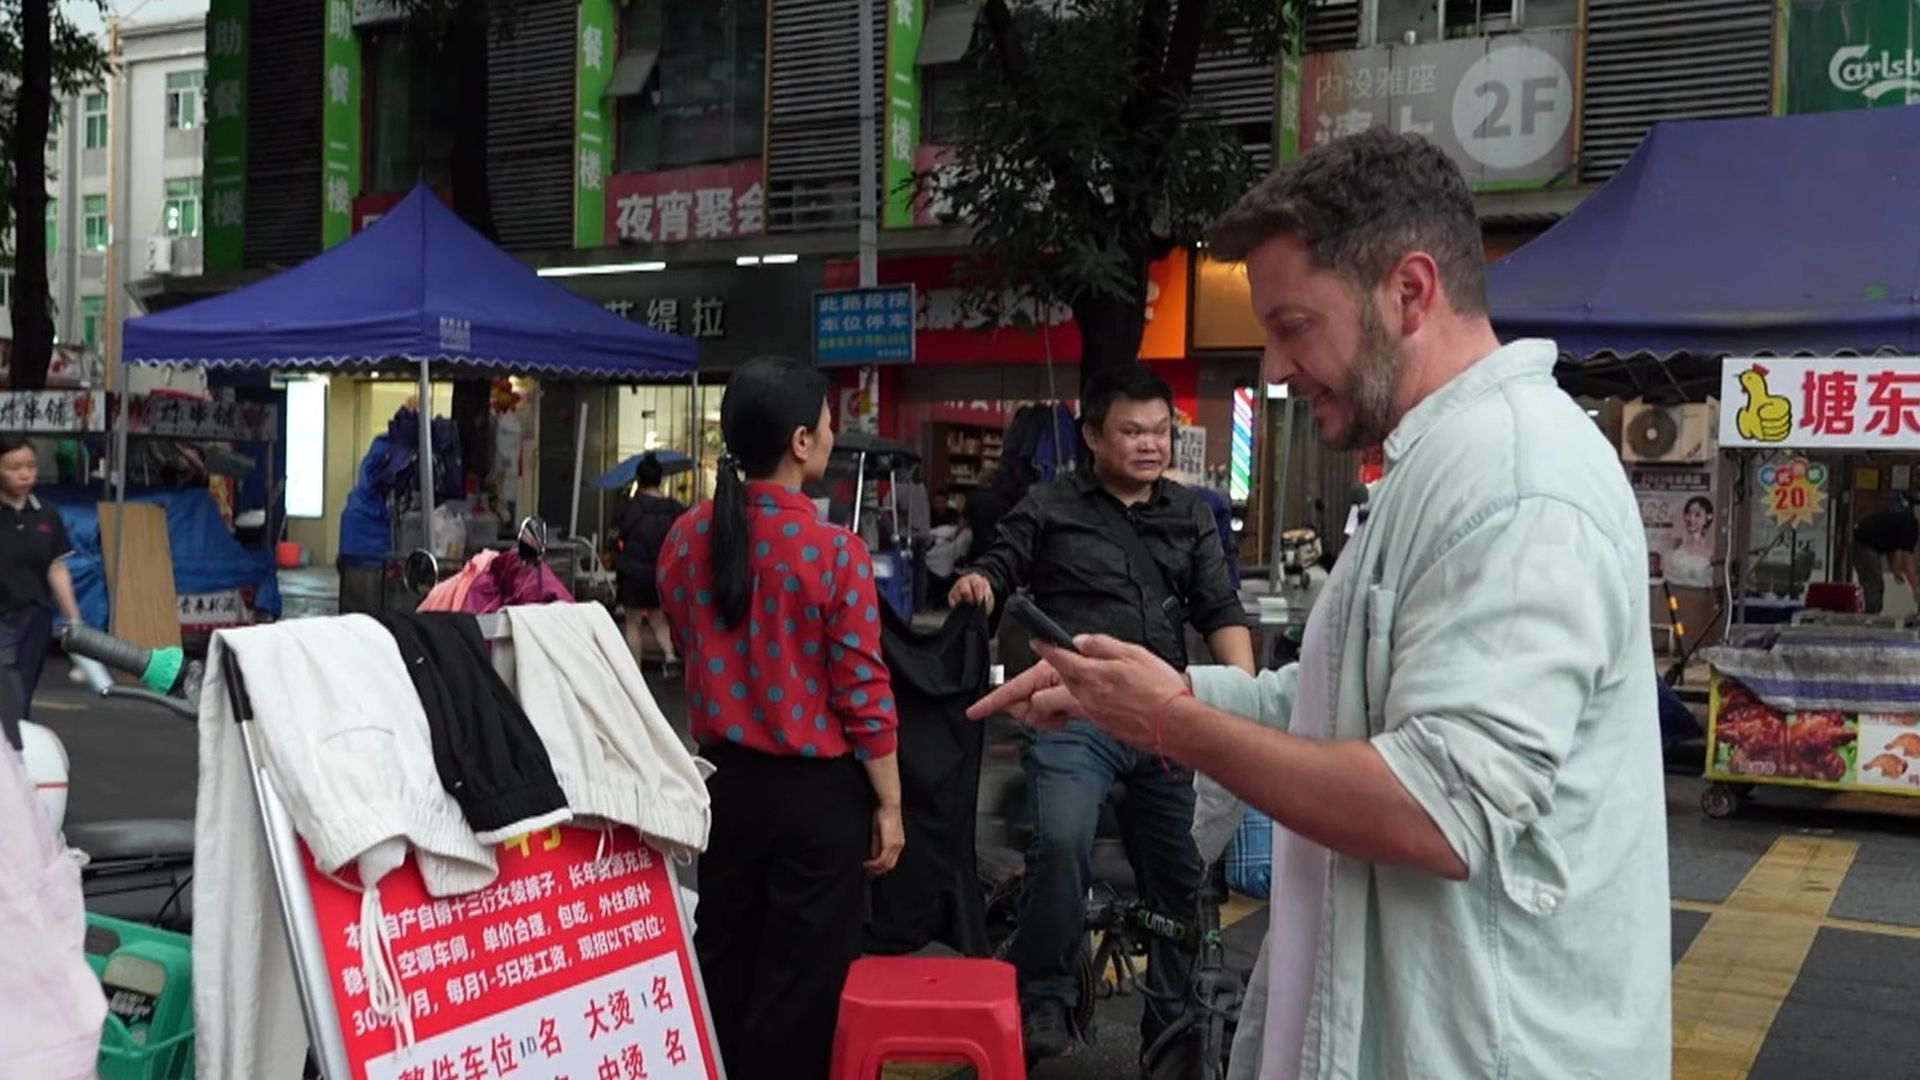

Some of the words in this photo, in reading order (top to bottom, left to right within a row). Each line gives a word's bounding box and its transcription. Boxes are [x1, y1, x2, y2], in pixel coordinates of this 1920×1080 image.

[1314, 63, 1437, 102] 内设雅座
[1472, 75, 1559, 139] 2F
[616, 182, 764, 241] 夜宵聚会
[1799, 370, 1920, 436] 塘东
[1775, 487, 1805, 510] 20
